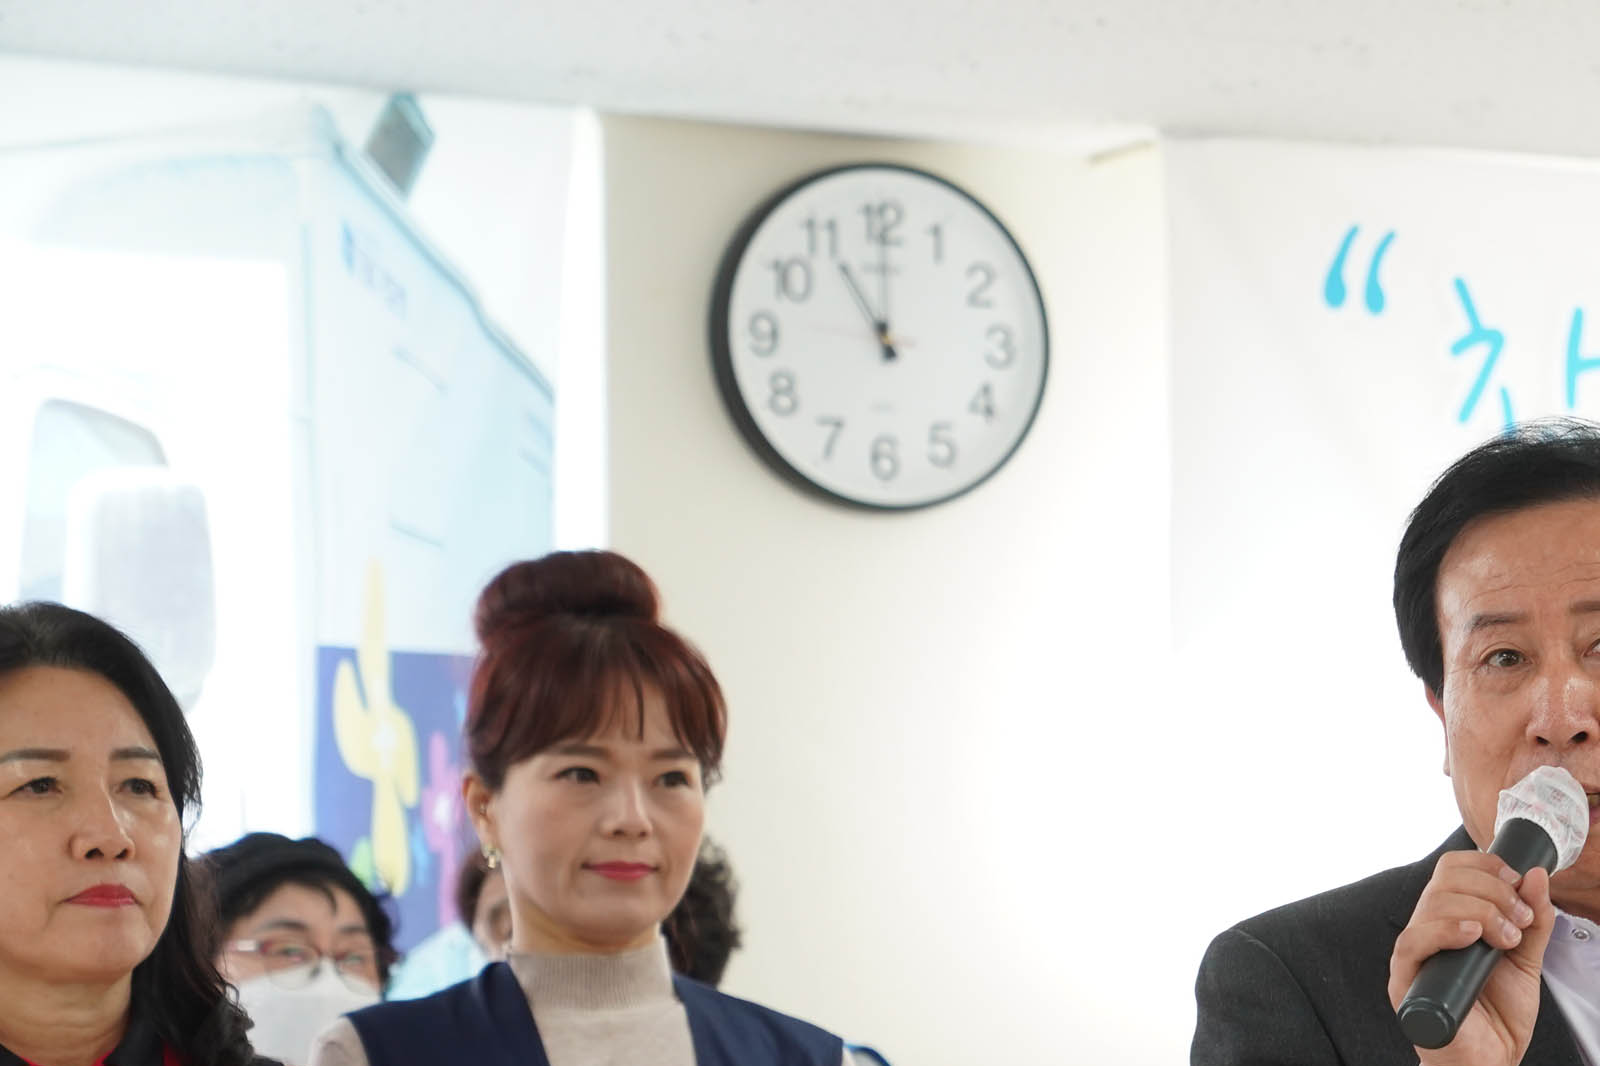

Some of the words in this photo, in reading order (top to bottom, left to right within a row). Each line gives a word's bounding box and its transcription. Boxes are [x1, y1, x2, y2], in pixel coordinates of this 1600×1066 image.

[802, 216, 836, 258] 11
[858, 200, 902, 246] 12
[927, 224, 942, 264] 1
[768, 256, 810, 303] 10
[965, 262, 994, 308] 2
[749, 311, 778, 357] 9
[984, 324, 1013, 370] 3
[769, 371, 797, 416] 8
[969, 382, 995, 422] 4
[816, 416, 843, 460] 7
[870, 435, 898, 481] 6
[927, 421, 955, 467] 5
